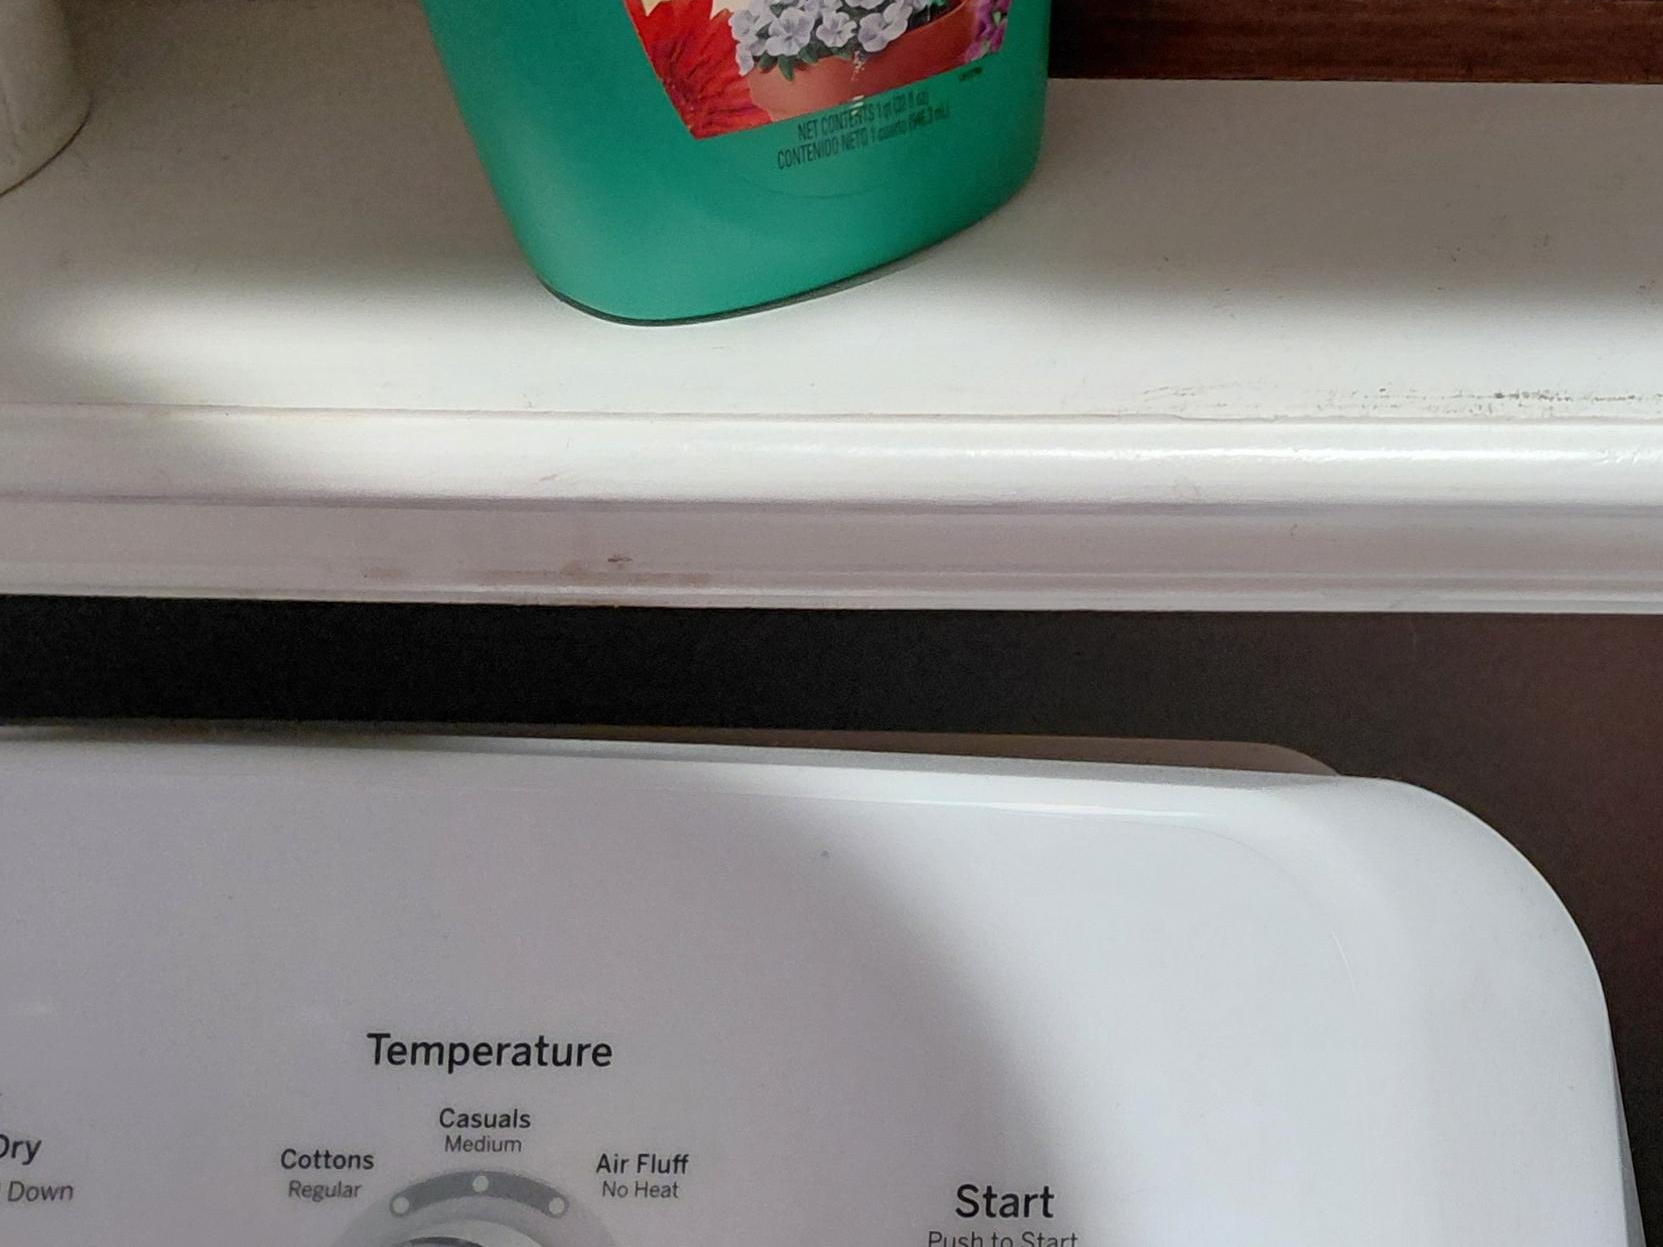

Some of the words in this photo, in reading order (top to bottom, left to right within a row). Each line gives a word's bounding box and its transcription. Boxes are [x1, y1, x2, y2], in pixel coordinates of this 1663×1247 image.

[797, 119, 818, 141] NET
[820, 105, 876, 134] CONTENTS
[777, 137, 840, 170] CONTENIDO
[840, 126, 870, 152] NETO
[367, 1033, 613, 1074] Temperature
[438, 1108, 531, 1130] Casuals
[444, 1134, 523, 1154] Medium
[280, 1149, 375, 1172] Cottons
[596, 1154, 630, 1175] Air
[637, 1153, 690, 1175] Fluff
[8, 1180, 74, 1202] Down
[288, 1179, 362, 1203] Regular
[602, 1180, 629, 1199] No
[634, 1180, 680, 1200] Heat
[955, 1183, 1055, 1219] Start
[928, 1230, 984, 1247] Push
[990, 1233, 1014, 1247] to
[1021, 1231, 1079, 1247] Start
